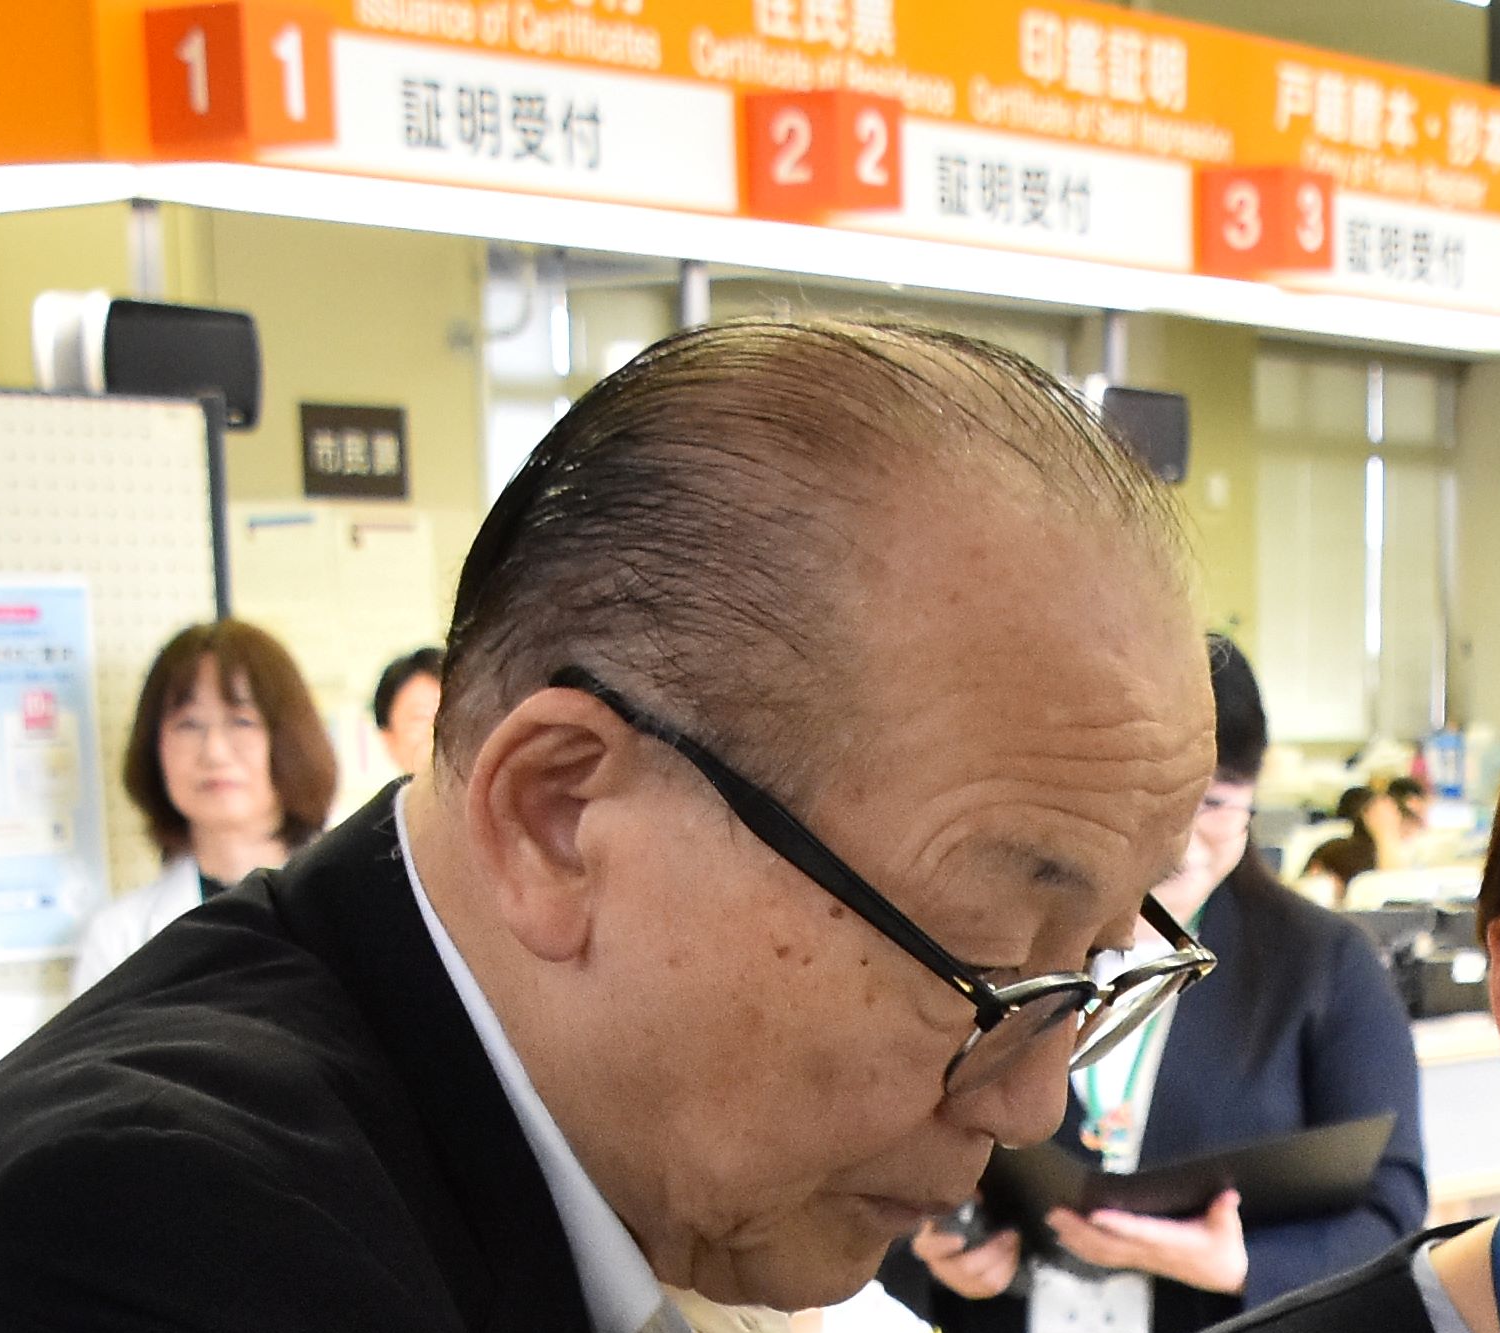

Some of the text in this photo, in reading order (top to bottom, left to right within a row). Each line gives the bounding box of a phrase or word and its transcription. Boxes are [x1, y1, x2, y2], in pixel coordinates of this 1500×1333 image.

[174, 26, 210, 116] 1
[271, 22, 306, 123] 1
[481, 10, 508, 44] of
[518, 11, 661, 70] Certificates
[401, 77, 603, 171] 証明受付
[771, 107, 812, 186] 2
[855, 110, 890, 187] 2
[934, 154, 1092, 236] 証明受付
[1222, 179, 1263, 250] 3
[1296, 182, 1326, 253] 3
[1346, 215, 1466, 291] 証明受付
